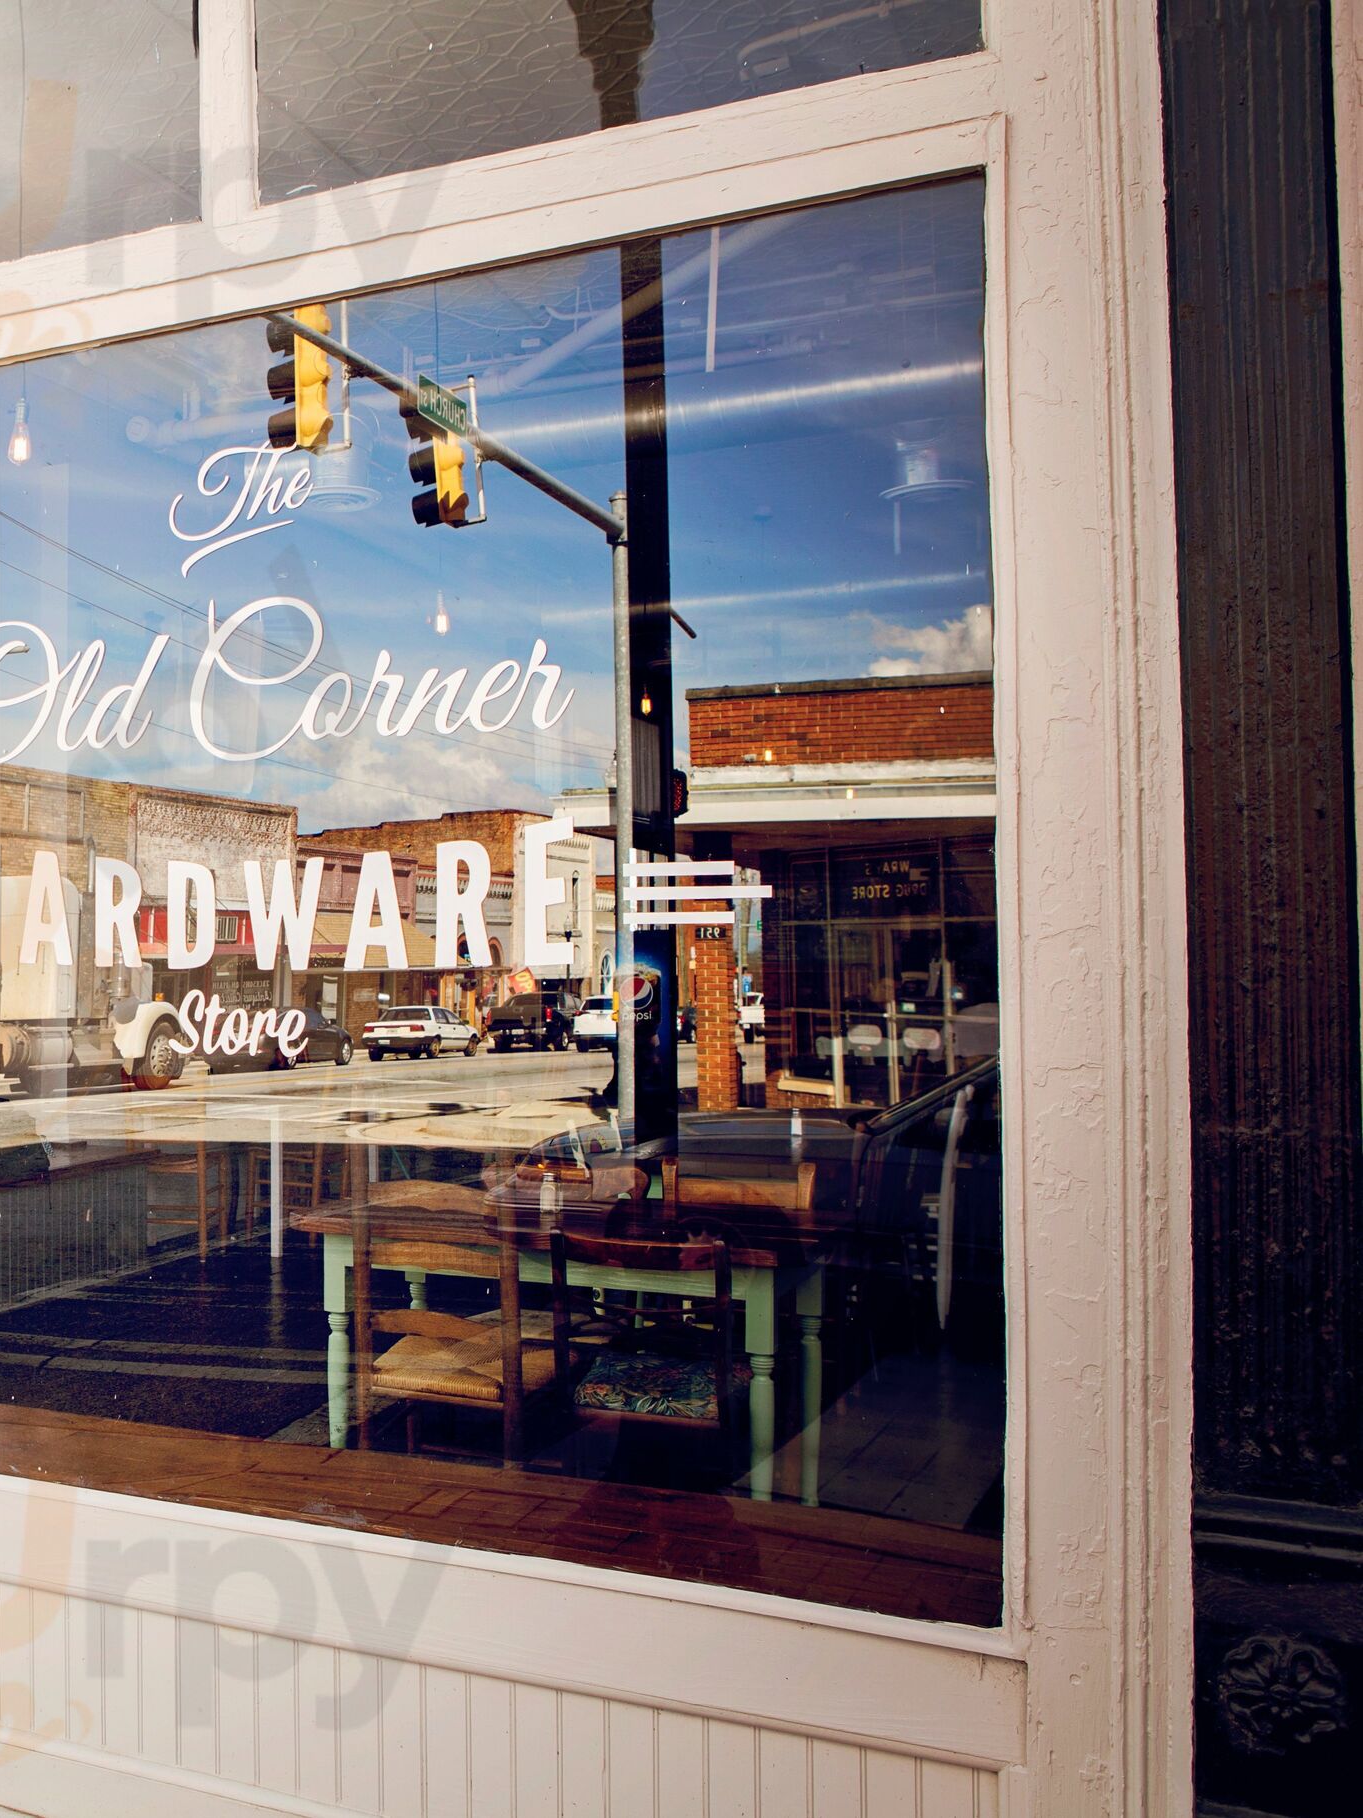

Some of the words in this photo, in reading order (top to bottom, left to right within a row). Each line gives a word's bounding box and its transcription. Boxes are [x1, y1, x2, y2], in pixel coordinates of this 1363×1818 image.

[169, 443, 313, 541] The
[191, 596, 574, 762] Corner
[169, 989, 309, 1058] Store
[622, 1011, 652, 1022] pepsi
